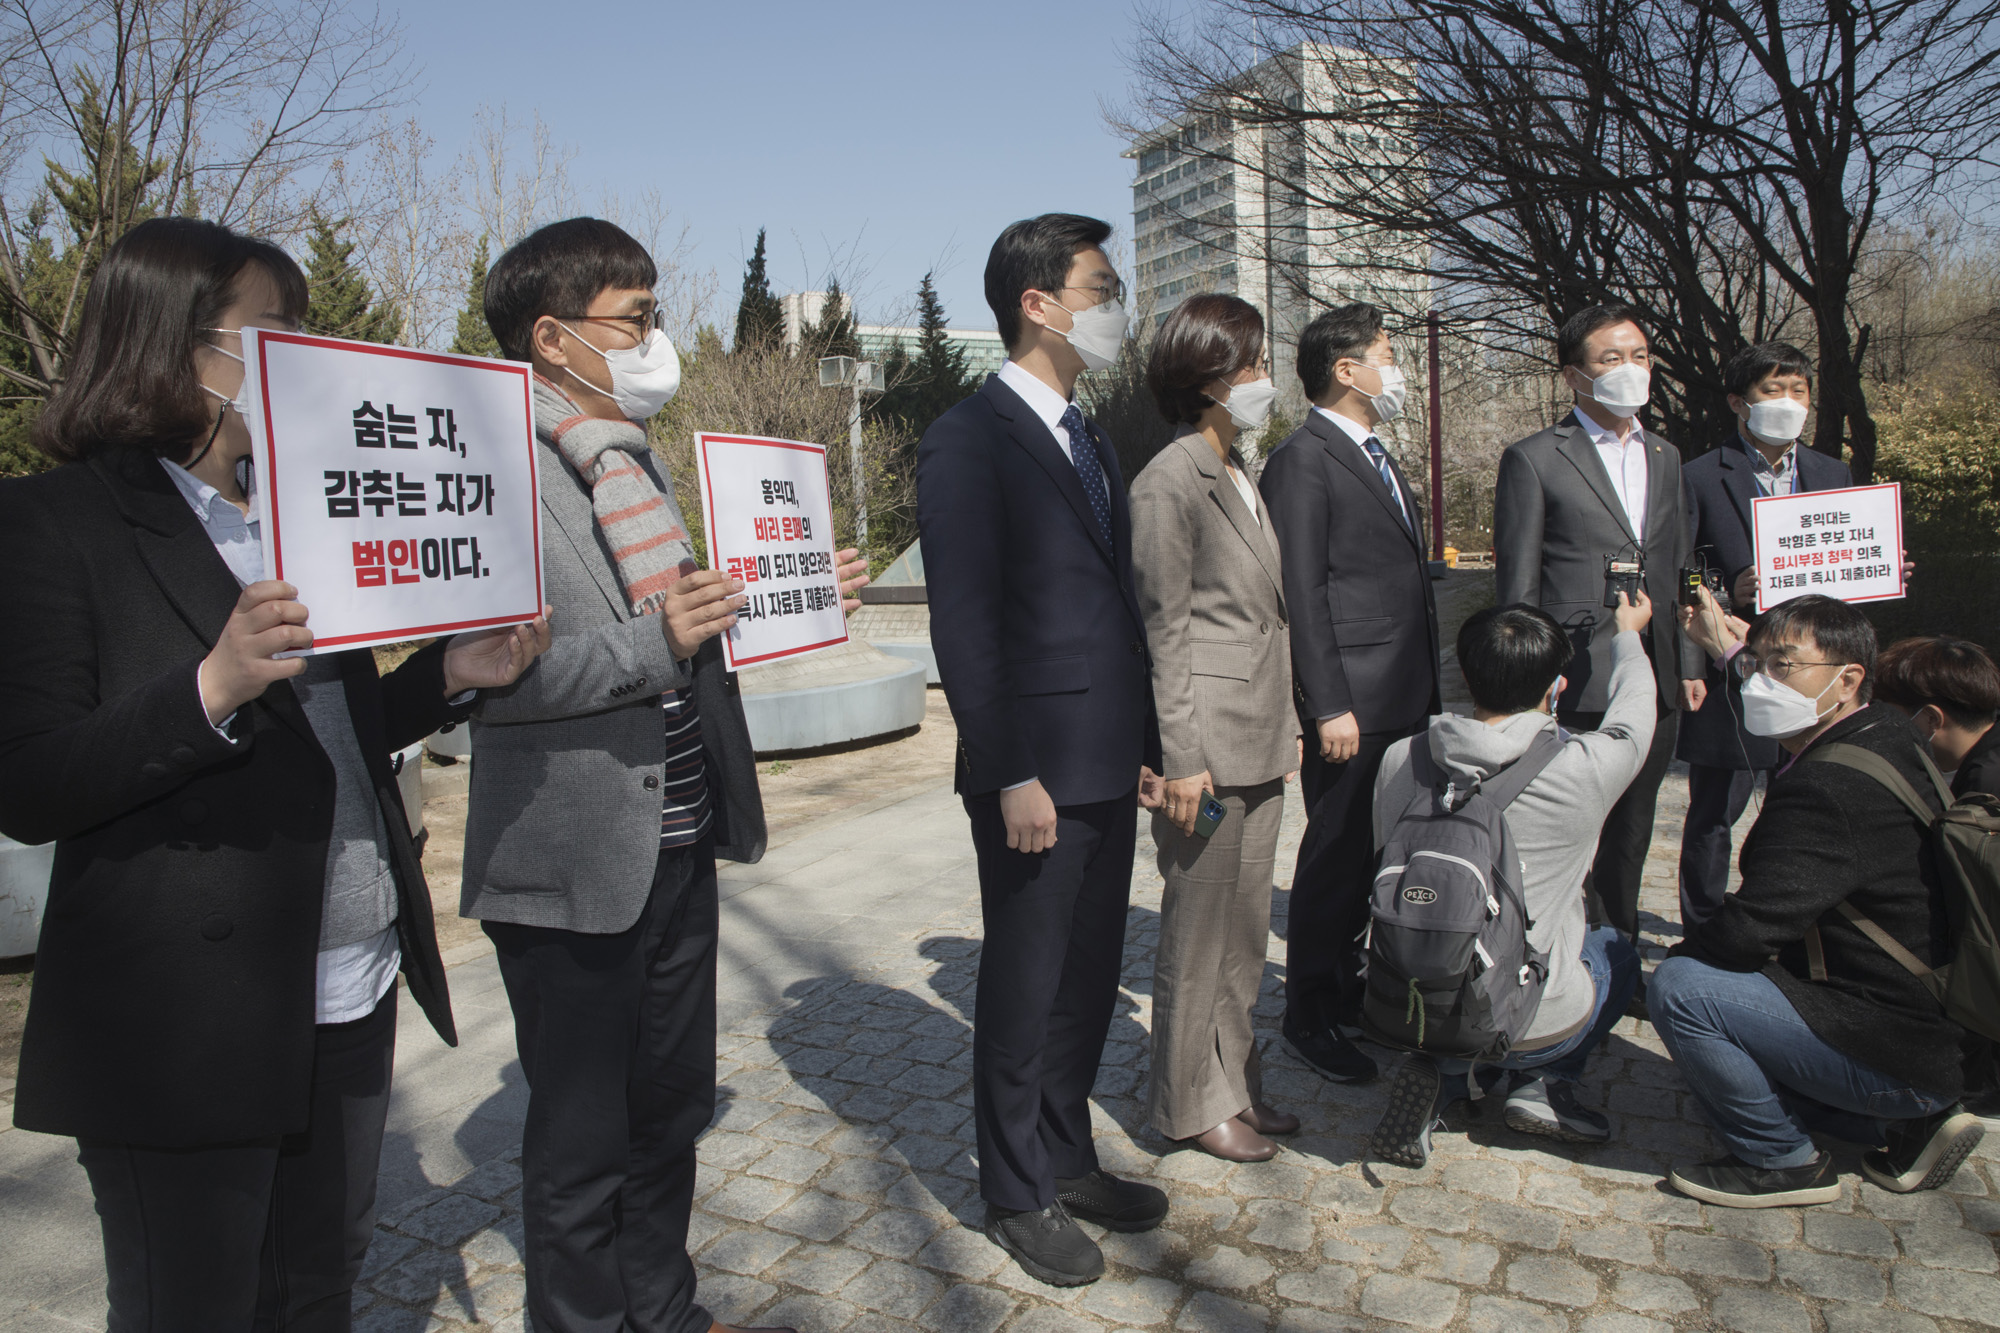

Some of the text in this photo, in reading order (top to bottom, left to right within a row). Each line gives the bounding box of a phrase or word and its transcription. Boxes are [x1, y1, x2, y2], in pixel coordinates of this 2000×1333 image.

[352, 400, 467, 458] 숨는 자,
[323, 469, 495, 518] 감추는 자가
[761, 478, 799, 509] 홍익대,
[753, 516, 781, 542] 비리
[1800, 511, 1851, 529] 홍익대는
[1778, 526, 1875, 549] 박형준 후보 자녀
[352, 536, 490, 588] 범인이다.
[727, 551, 833, 583] 공범이 되지 않으려면
[1772, 544, 1882, 570] 입시부정 청탁 의혹
[1769, 564, 1891, 589] 자료를 즉시 제출하라
[767, 588, 804, 617] 자료를
[804, 585, 838, 612] 제출하라
